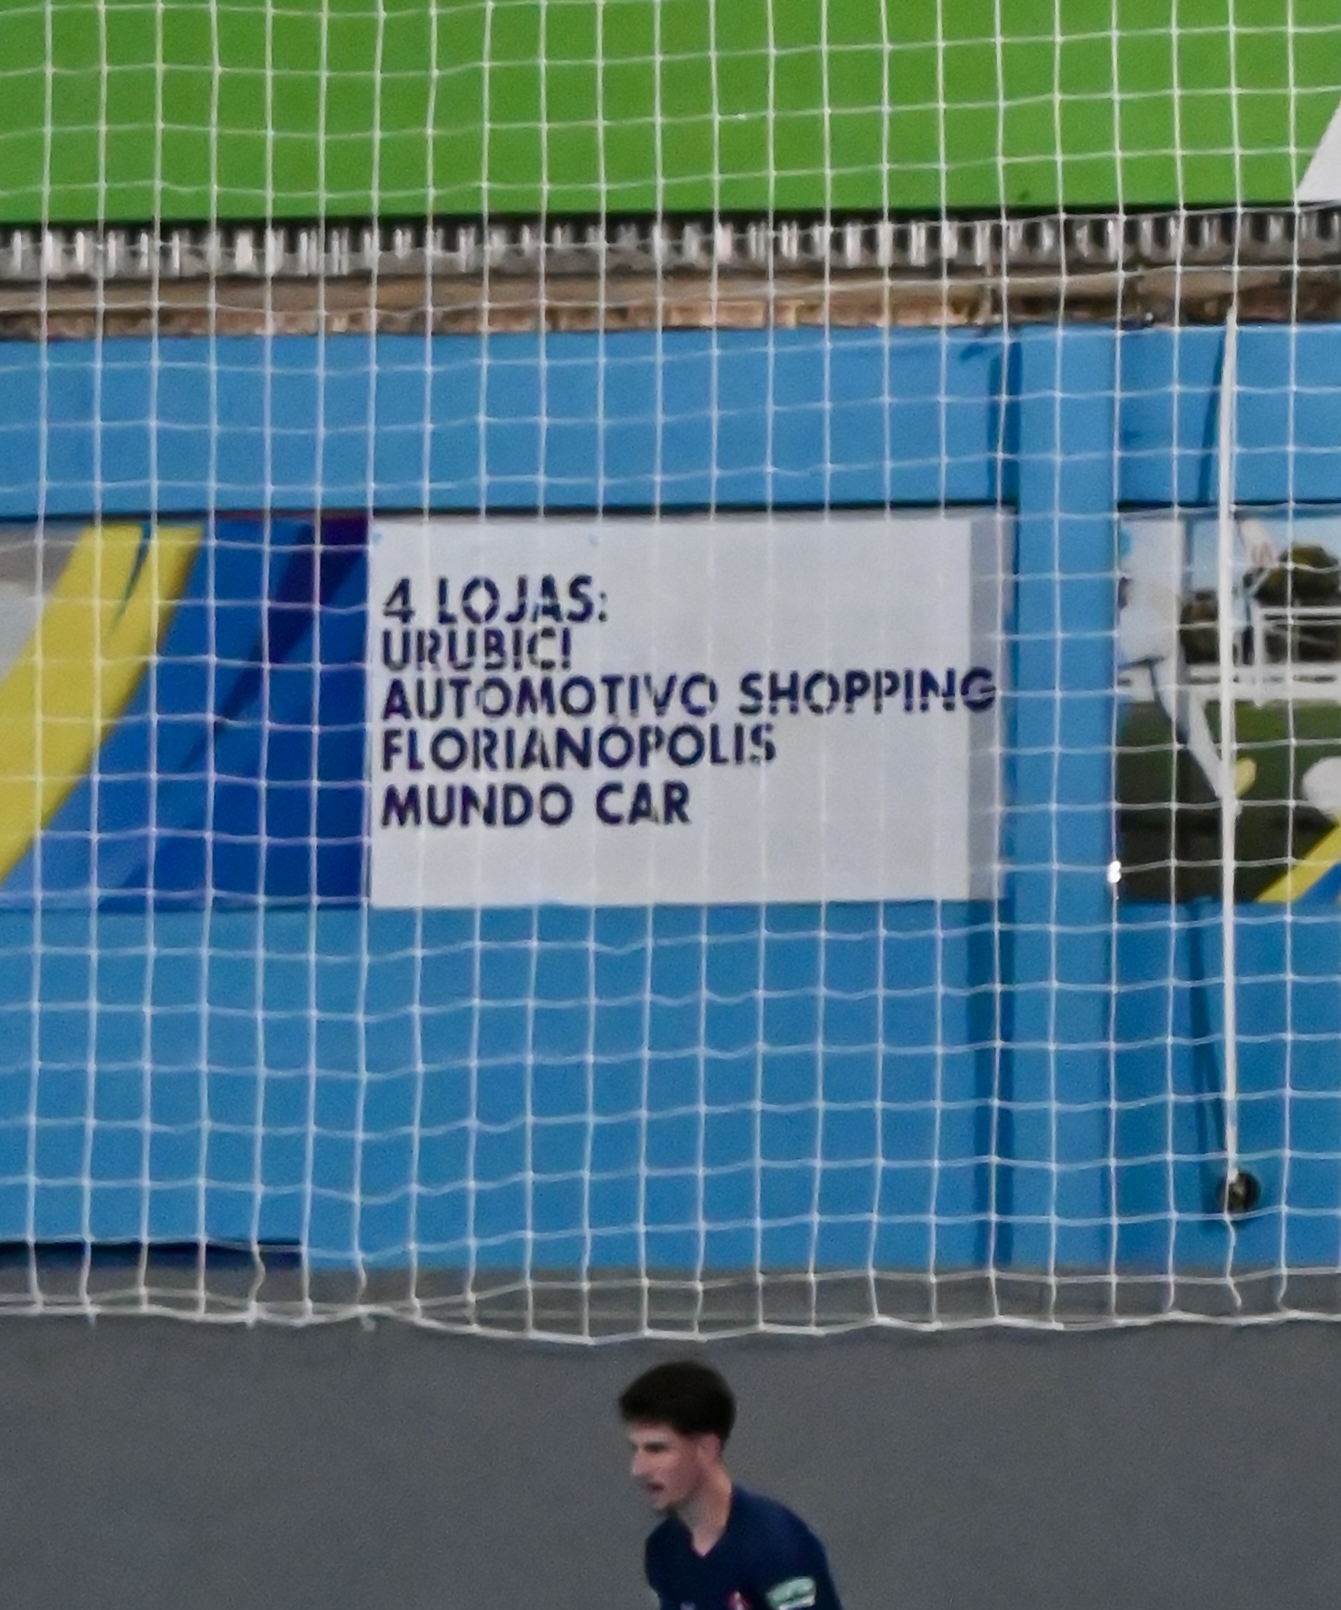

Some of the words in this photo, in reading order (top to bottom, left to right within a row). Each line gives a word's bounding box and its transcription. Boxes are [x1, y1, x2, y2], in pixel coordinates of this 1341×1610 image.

[383, 576, 415, 624] 4
[438, 573, 607, 624] LOJAS:
[381, 672, 718, 721] AUTOMOTIVO
[738, 666, 997, 714] SHOPPING
[381, 723, 777, 773] FLORIANOPOLIS
[380, 784, 573, 829] MUNDO
[595, 780, 692, 826] CAR
